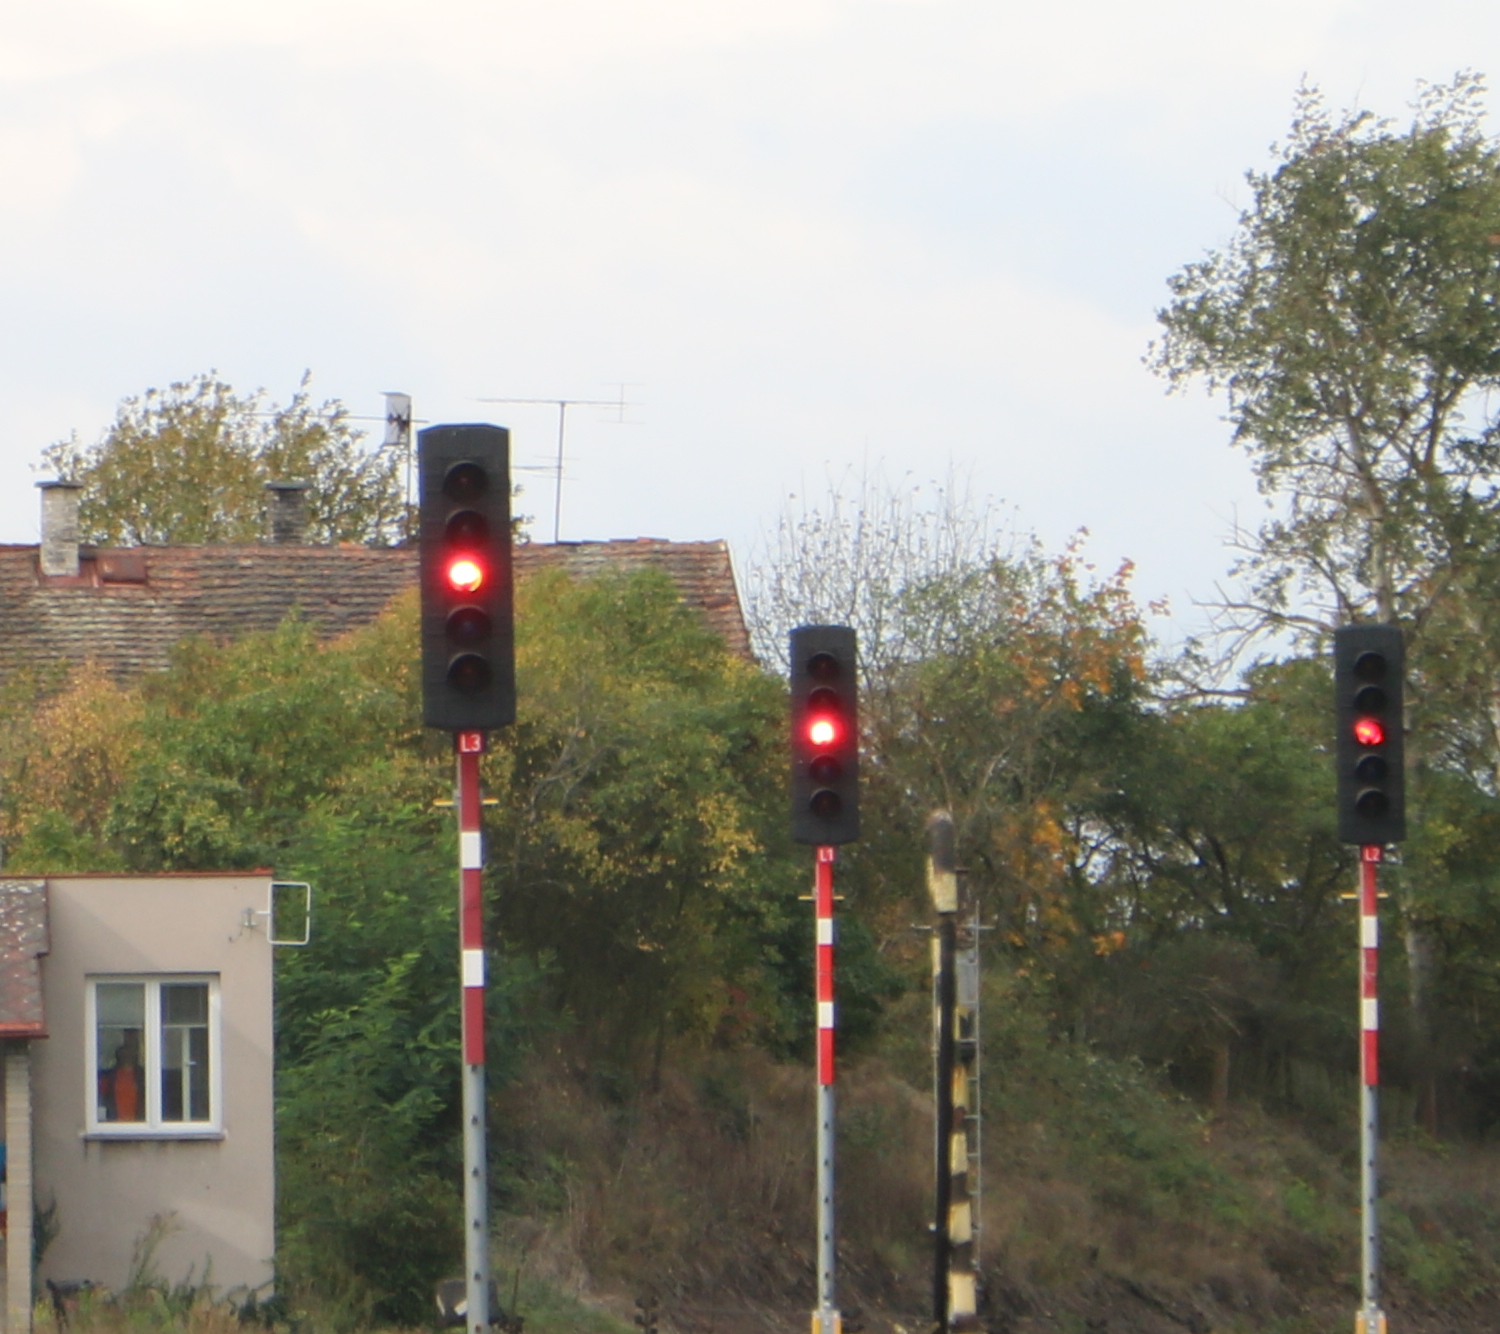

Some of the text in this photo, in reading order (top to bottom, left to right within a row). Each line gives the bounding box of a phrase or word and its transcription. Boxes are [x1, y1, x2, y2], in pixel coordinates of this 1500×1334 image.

[461, 733, 481, 752] L3
[820, 847, 834, 862] L1
[1365, 847, 1380, 862] L2
